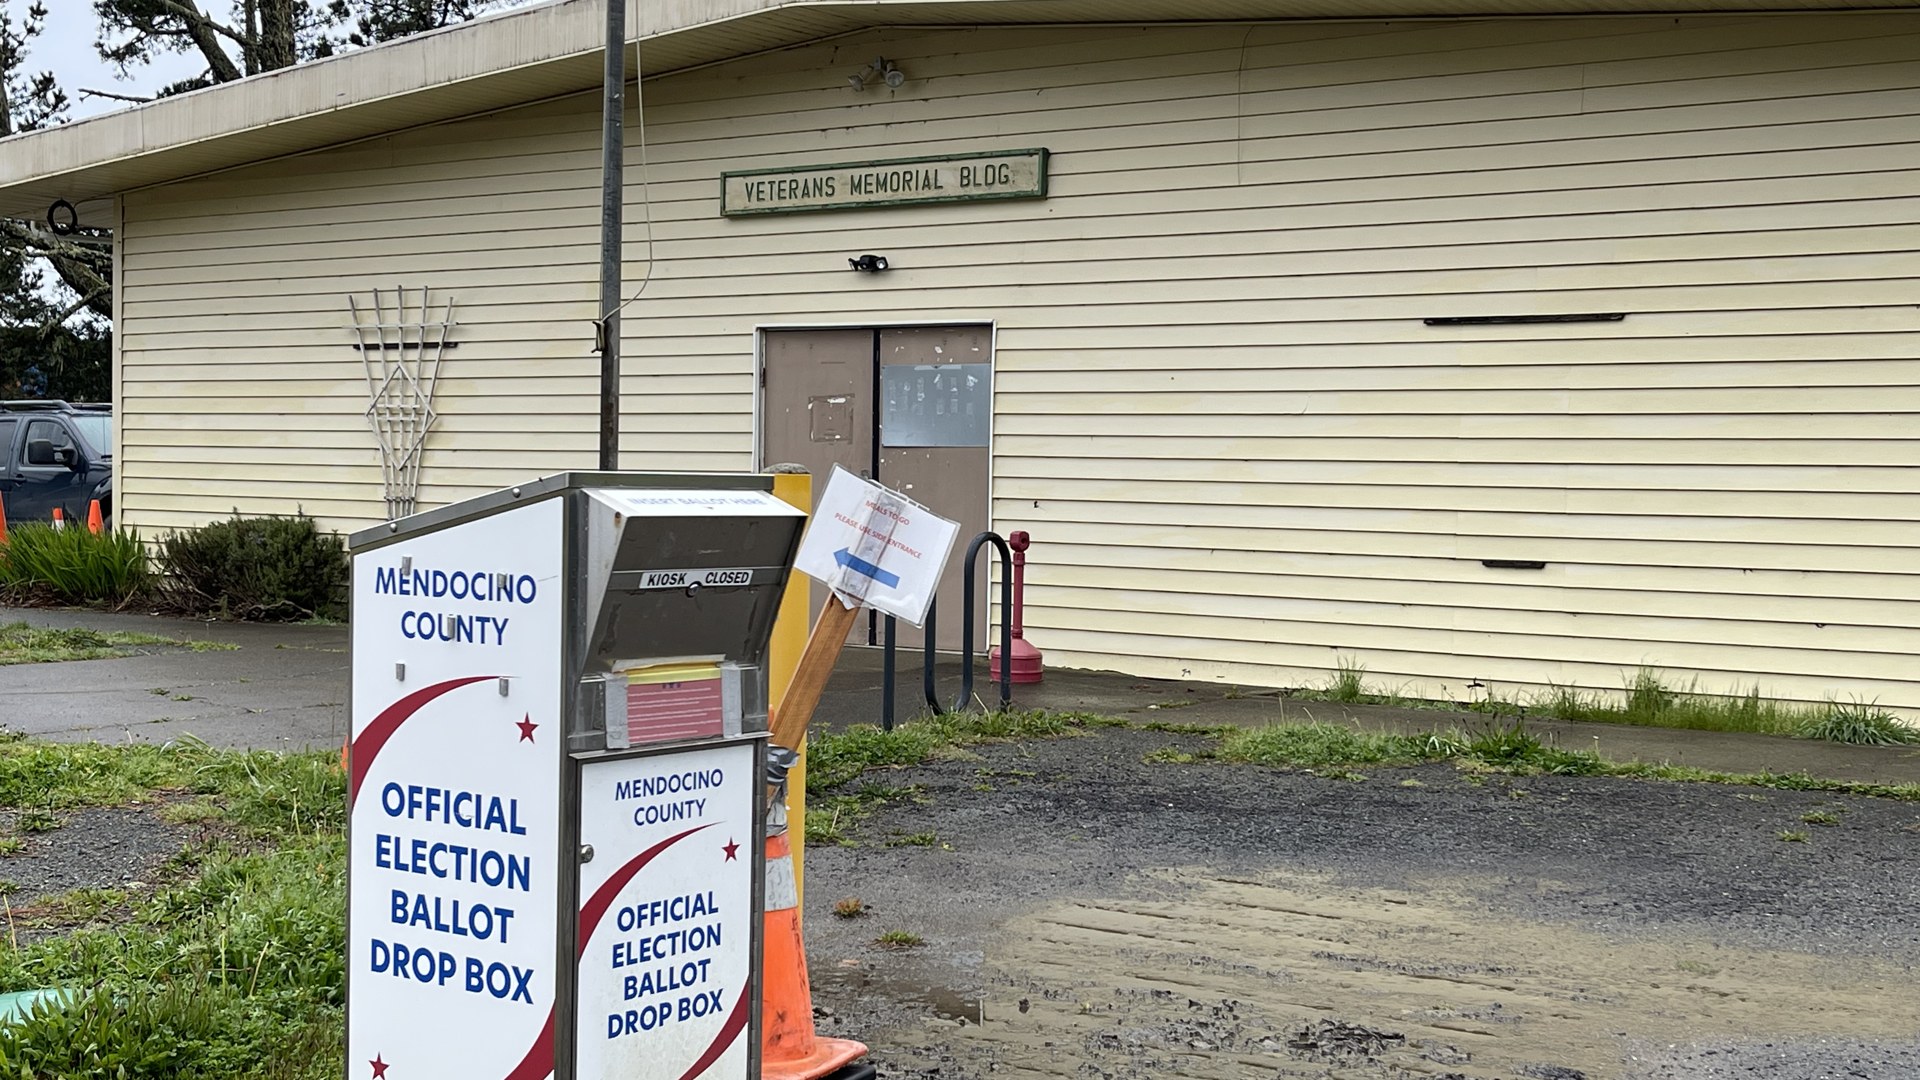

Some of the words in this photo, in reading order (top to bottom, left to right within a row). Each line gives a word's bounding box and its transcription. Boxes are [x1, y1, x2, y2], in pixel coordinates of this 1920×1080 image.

[745, 176, 836, 202] VETERANS
[850, 168, 943, 196] MEMORIAL
[960, 163, 1016, 188] BLDG.
[865, 500, 888, 516] MEALS
[888, 511, 899, 520] TO
[899, 516, 910, 525] GO
[834, 512, 858, 529] PLEASE
[859, 525, 872, 536] USE
[872, 530, 887, 542] SIDE
[887, 538, 923, 559] ENTRANCE
[375, 566, 537, 604] MENDOCINO
[647, 573, 687, 586] KIOSK
[705, 571, 749, 584] CLOSED
[401, 610, 509, 645] COUNTY
[615, 769, 723, 801] MENDOCINO
[382, 782, 526, 835] OFFICIAL
[634, 798, 706, 826] COUNTY
[376, 833, 530, 892] ELECTION
[391, 889, 514, 943] BALLOT
[617, 890, 719, 932] OFFICIAL
[612, 922, 721, 969] ELECTION
[371, 938, 457, 986] DROP
[466, 956, 534, 1005] BOX
[624, 958, 711, 1001] BALLOT
[608, 1002, 672, 1039] DROP
[678, 988, 724, 1022] BOX
